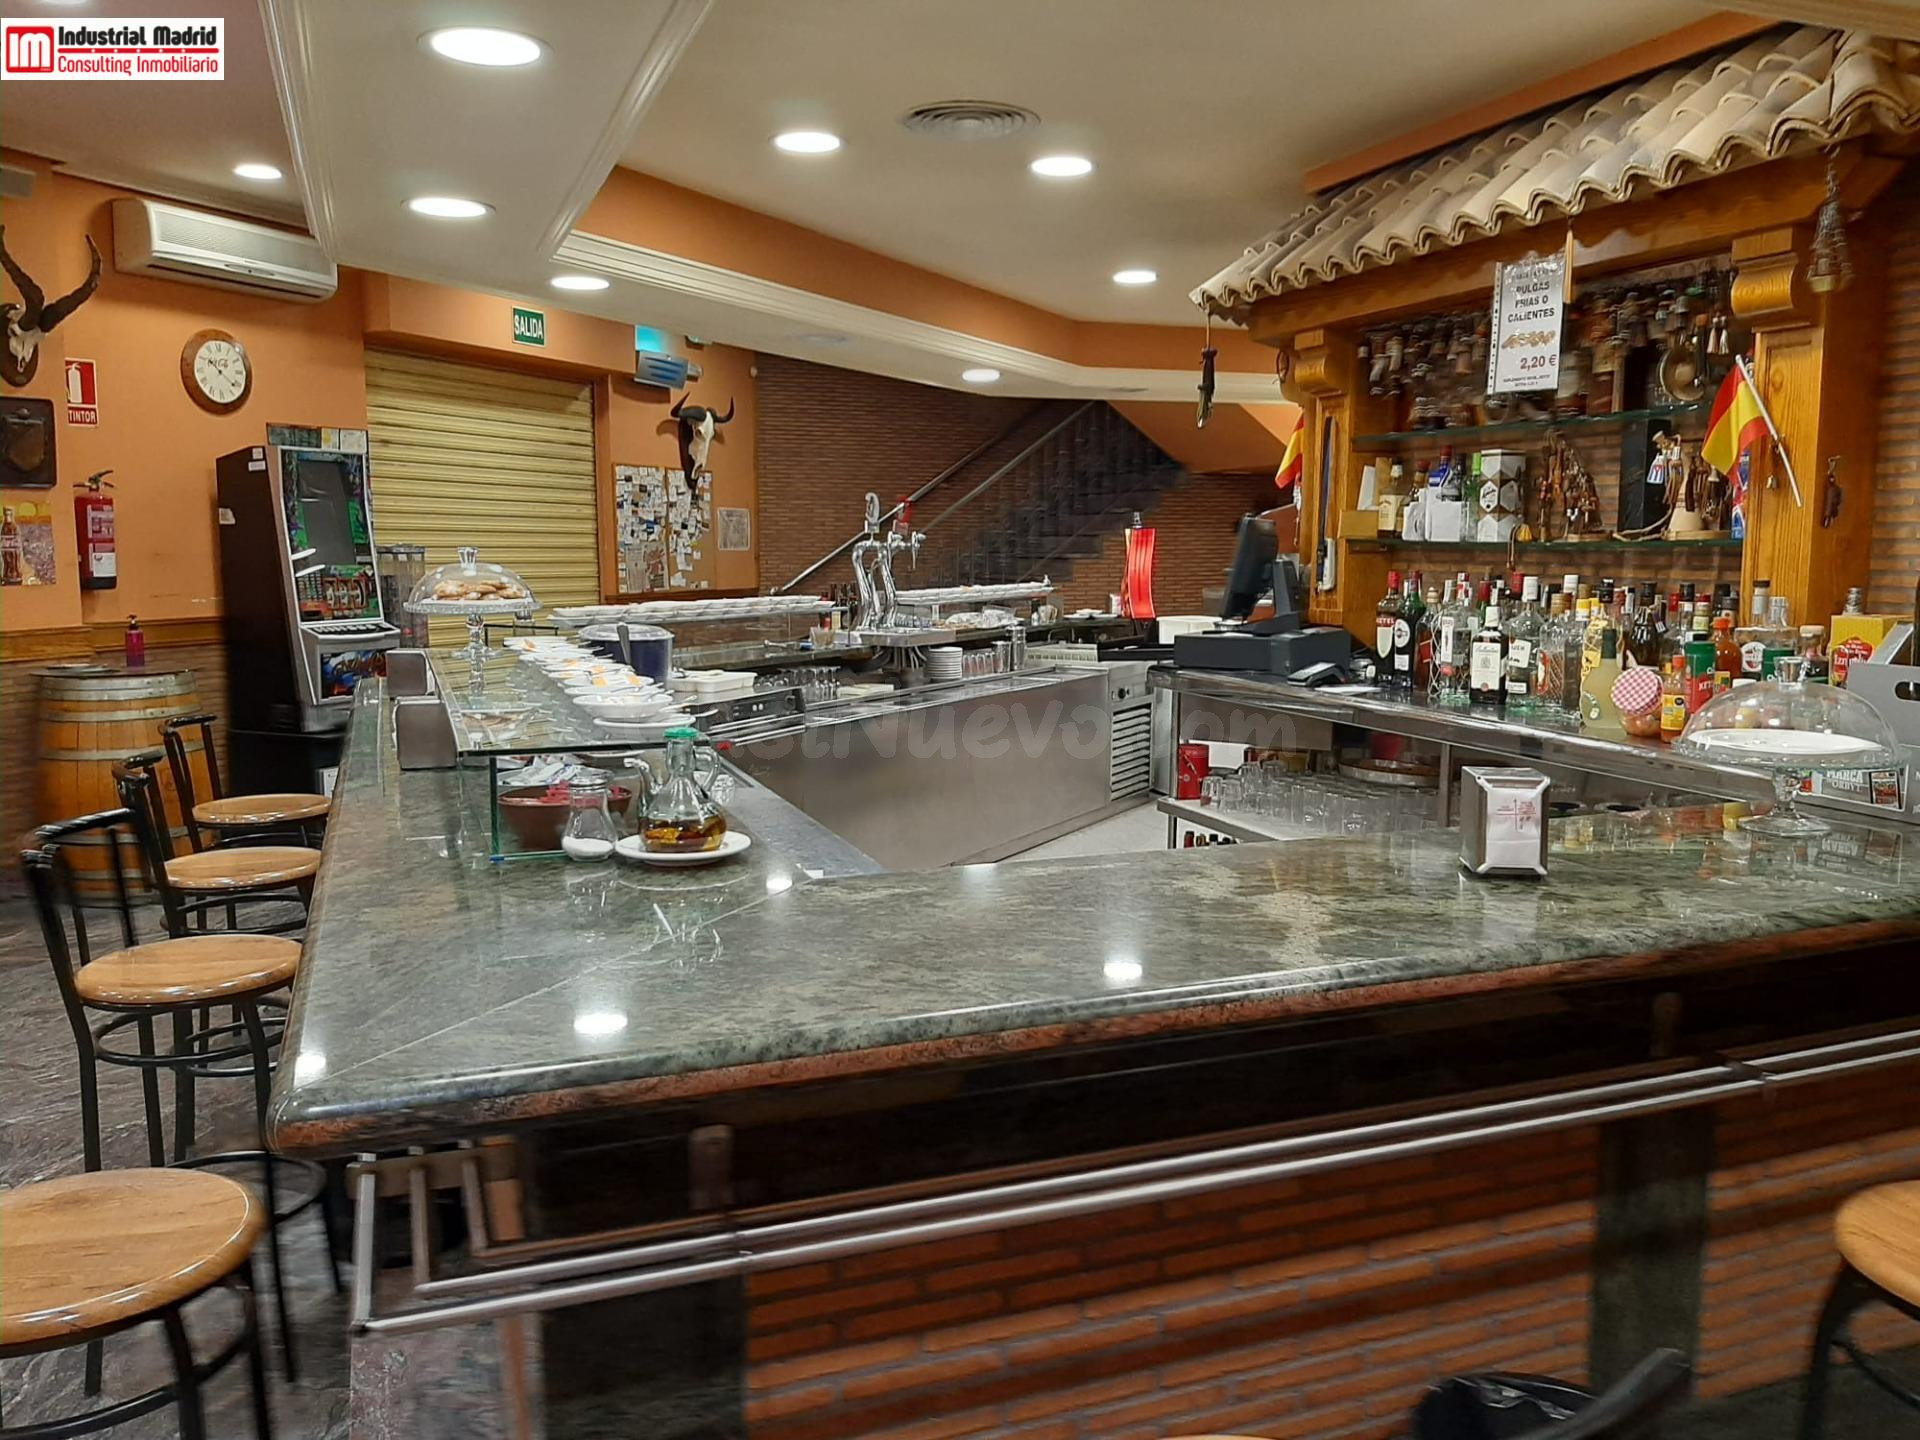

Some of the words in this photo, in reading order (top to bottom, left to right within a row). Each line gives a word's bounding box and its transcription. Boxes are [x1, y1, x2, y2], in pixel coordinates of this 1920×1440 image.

[1508, 307, 1555, 323] CALIENTES
[514, 314, 544, 339] SALIDA
[1520, 355, 1546, 371] 2,20
[1549, 354, 1557, 366] €
